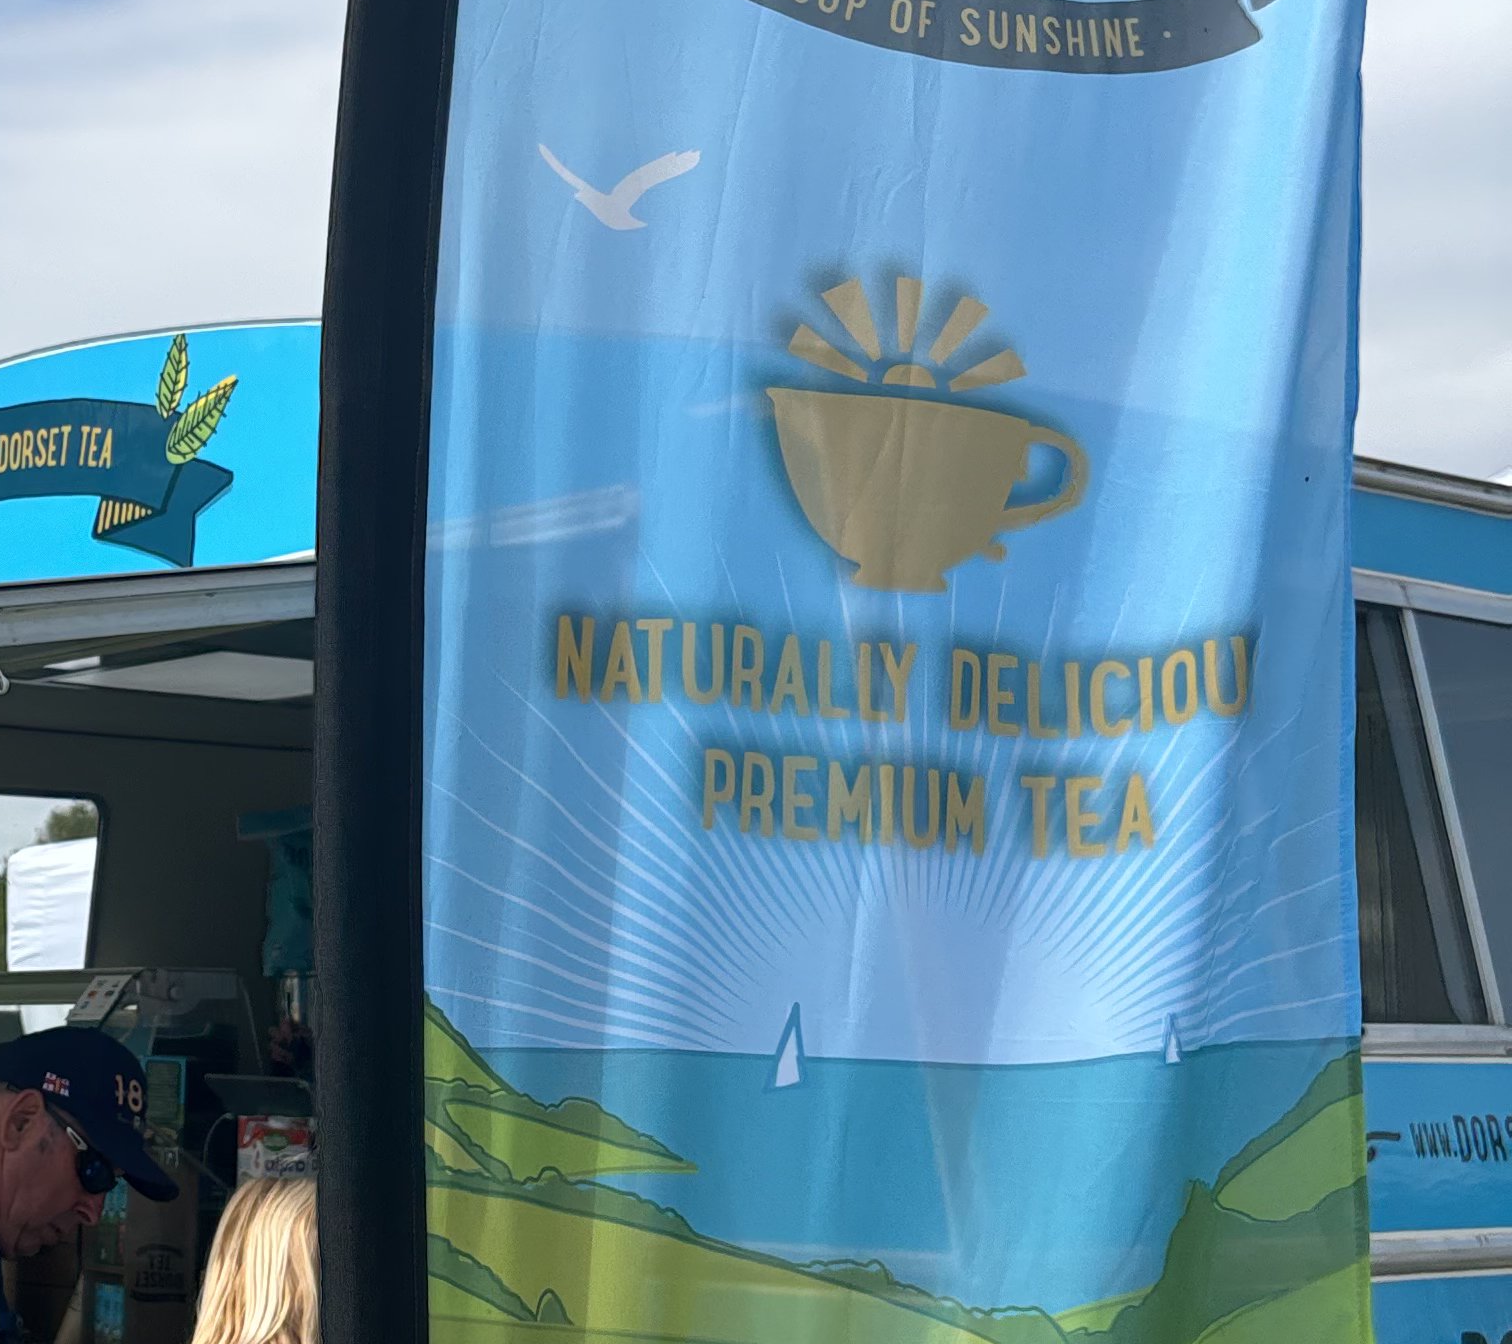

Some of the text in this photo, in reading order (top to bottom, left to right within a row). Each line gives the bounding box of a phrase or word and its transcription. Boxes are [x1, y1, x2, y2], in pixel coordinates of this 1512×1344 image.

[960, 7, 1146, 58] SUNSHINE
[80, 424, 114, 469] TEA
[555, 614, 1256, 739] NATURALLY DELICIOU
[701, 747, 1157, 860] PREMIUM TEA
[115, 1074, 143, 1113] 18
